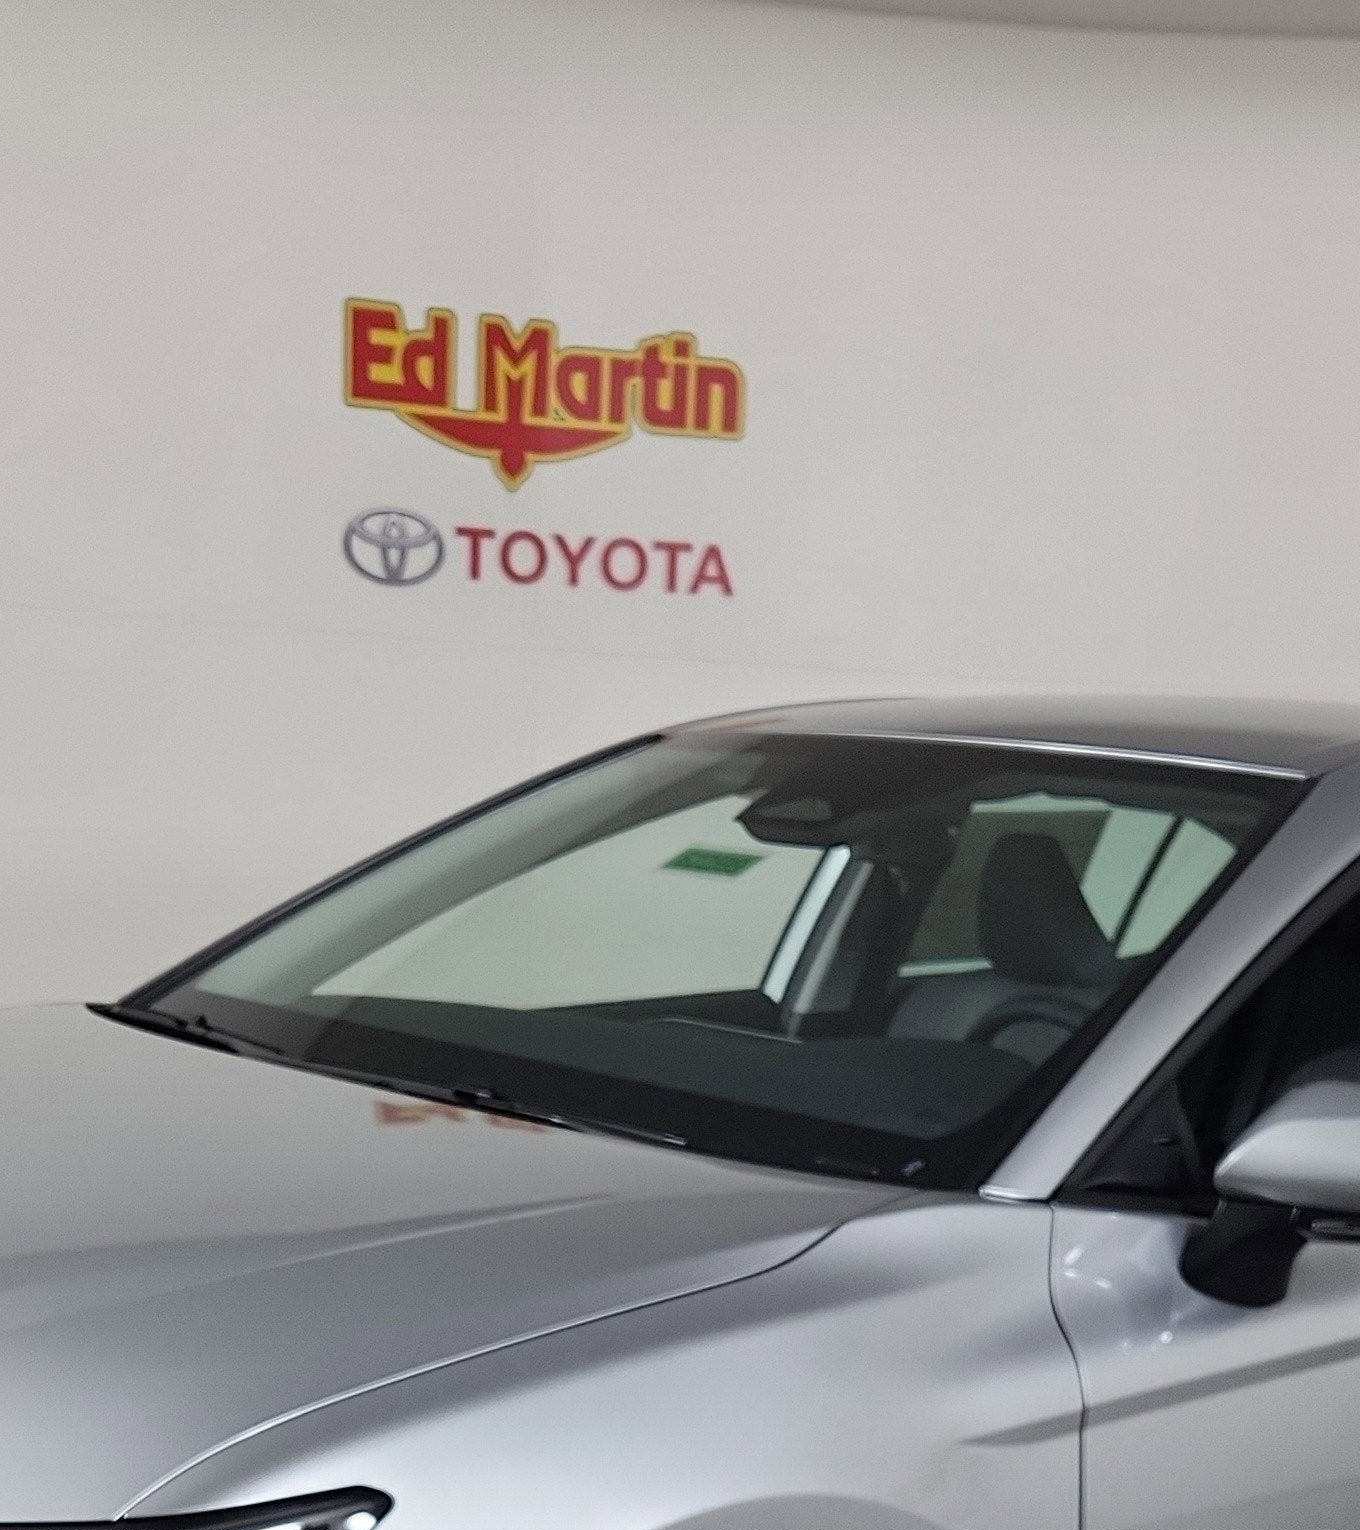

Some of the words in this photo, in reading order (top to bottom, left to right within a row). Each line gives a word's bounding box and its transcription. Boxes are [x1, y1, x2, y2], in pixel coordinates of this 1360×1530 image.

[346, 300, 453, 410] Ed
[480, 315, 743, 440] Martin
[454, 525, 735, 597] TOYOTA
